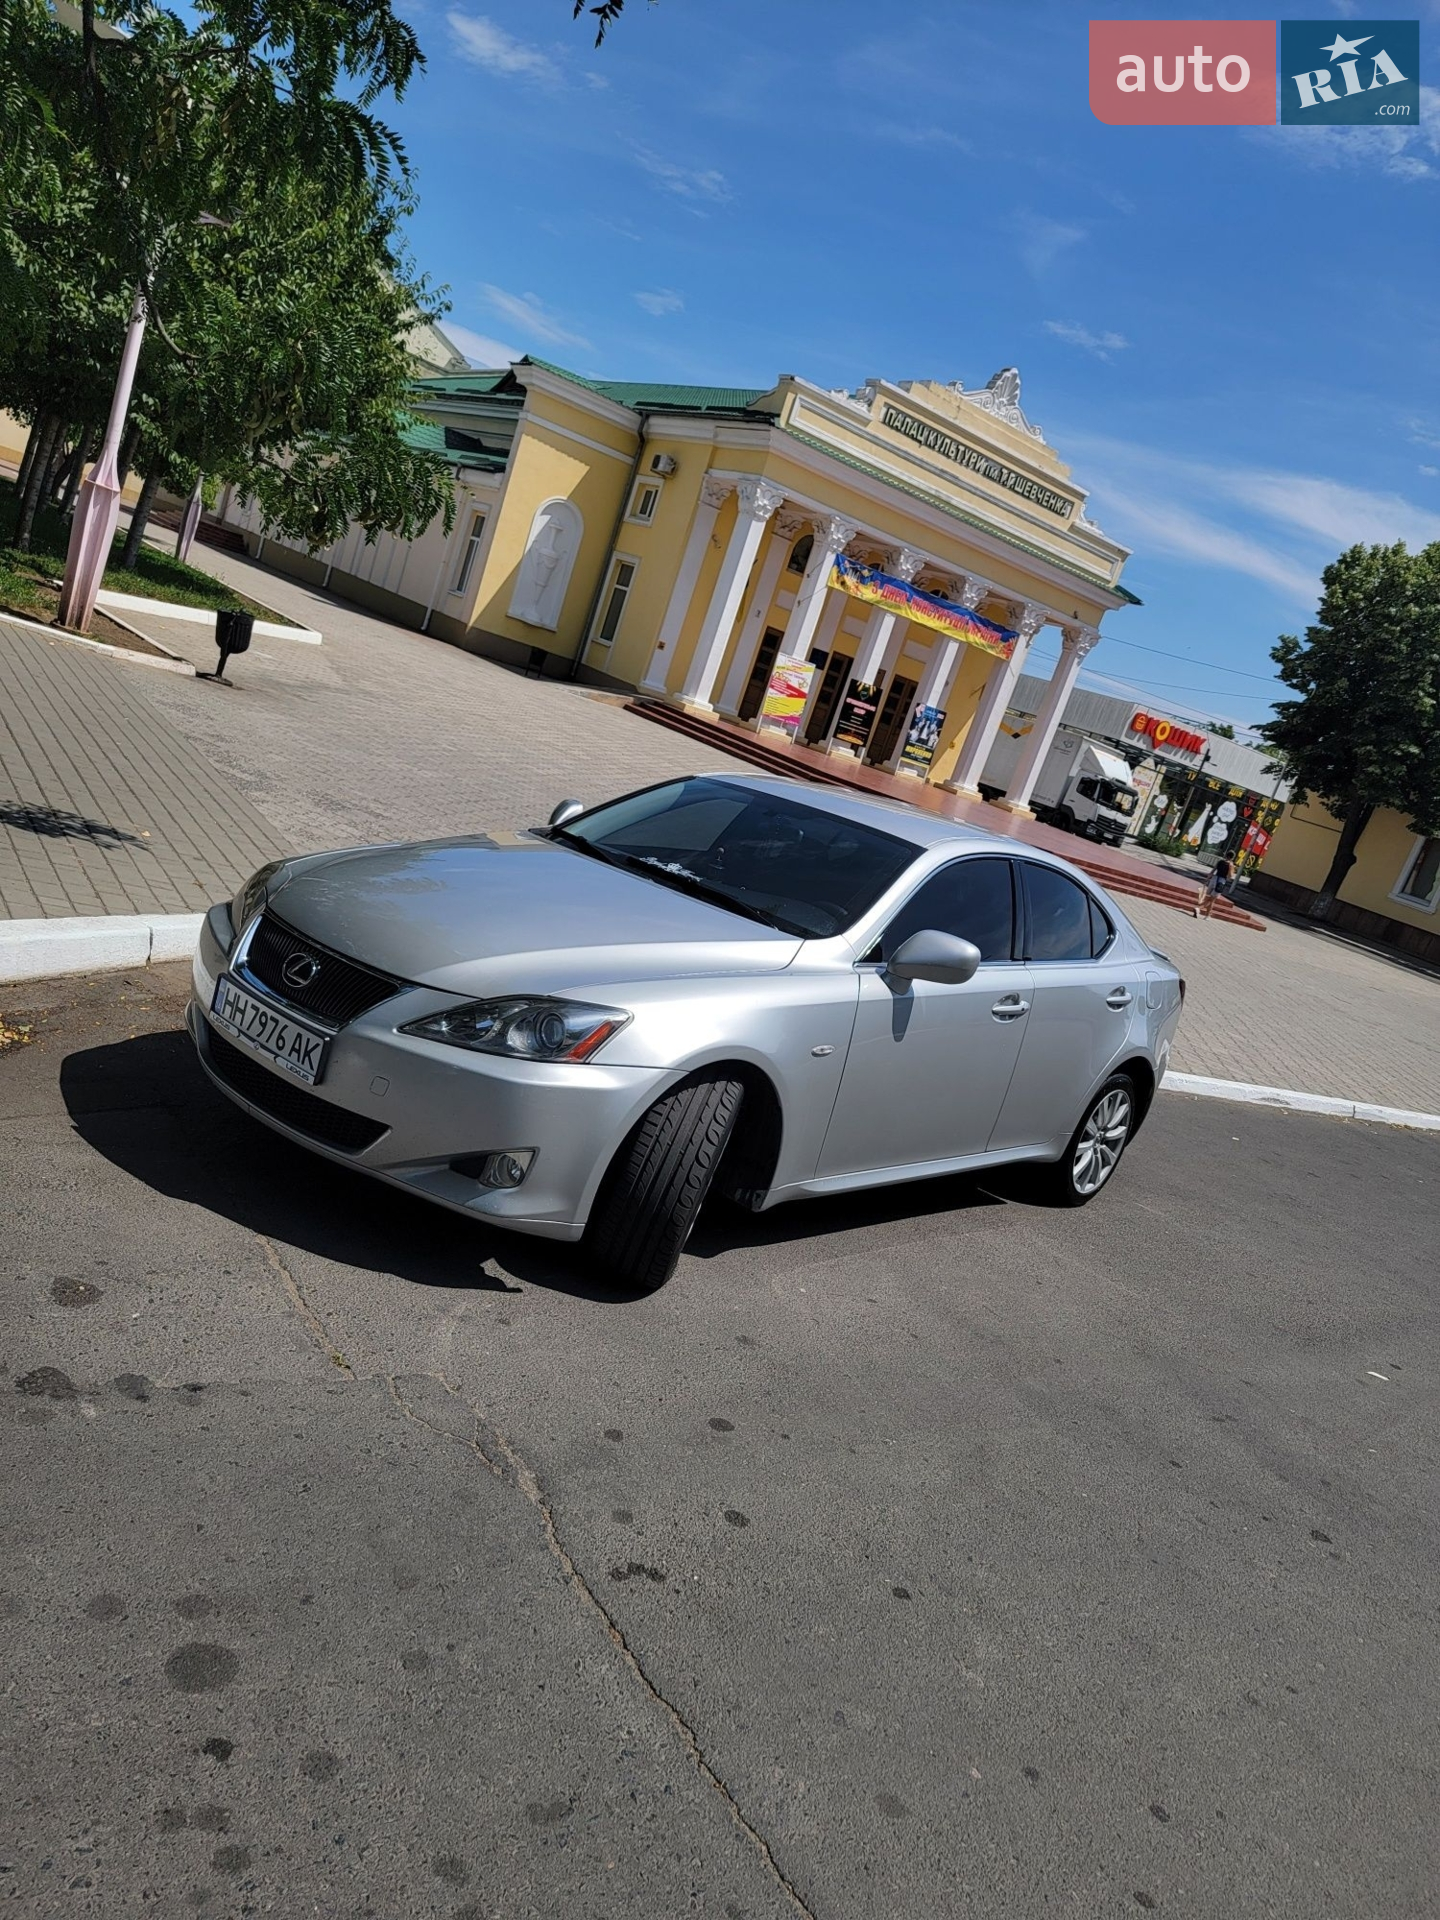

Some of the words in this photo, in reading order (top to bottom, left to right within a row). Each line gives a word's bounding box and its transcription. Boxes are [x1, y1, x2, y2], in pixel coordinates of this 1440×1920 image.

[885, 408, 926, 445] ПАЛАЦ
[927, 430, 987, 474] КУЛЬТУРИ
[1014, 476, 1068, 517] ШЕВЧЕНКА
[871, 580, 880, 595] З
[879, 584, 908, 607] ДНЕМ
[911, 595, 970, 630] КОНСТИТУЦІЇ
[966, 619, 1002, 646] УКРАЇНИ
[1143, 716, 1208, 755] КОШИК
[246, 1003, 289, 1051] 7976
[285, 1063, 310, 1082] LEXUS
